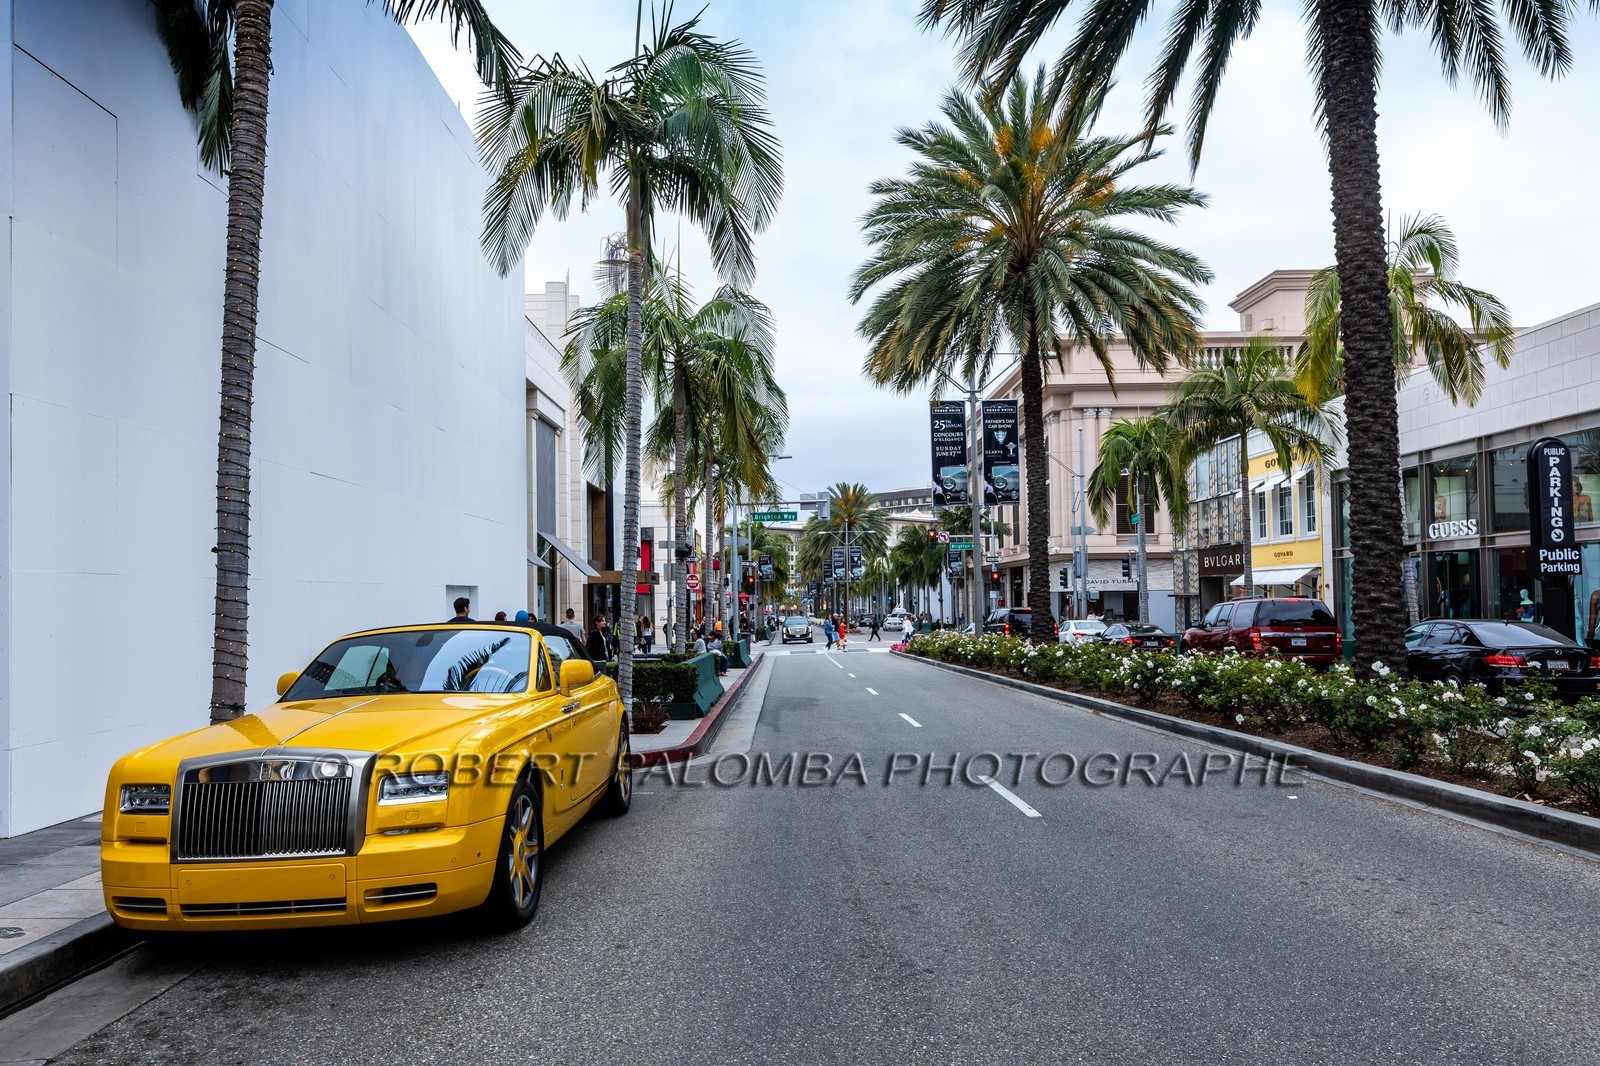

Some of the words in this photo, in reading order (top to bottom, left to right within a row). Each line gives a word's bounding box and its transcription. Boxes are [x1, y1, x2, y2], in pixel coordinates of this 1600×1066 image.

[1543, 447, 1566, 456] PUBLIC
[1549, 456, 1564, 528] PARKING
[1428, 518, 1478, 539] GUESS
[1273, 550, 1294, 558] GOYARD
[1539, 549, 1580, 561] Public
[1540, 561, 1580, 574] Parking
